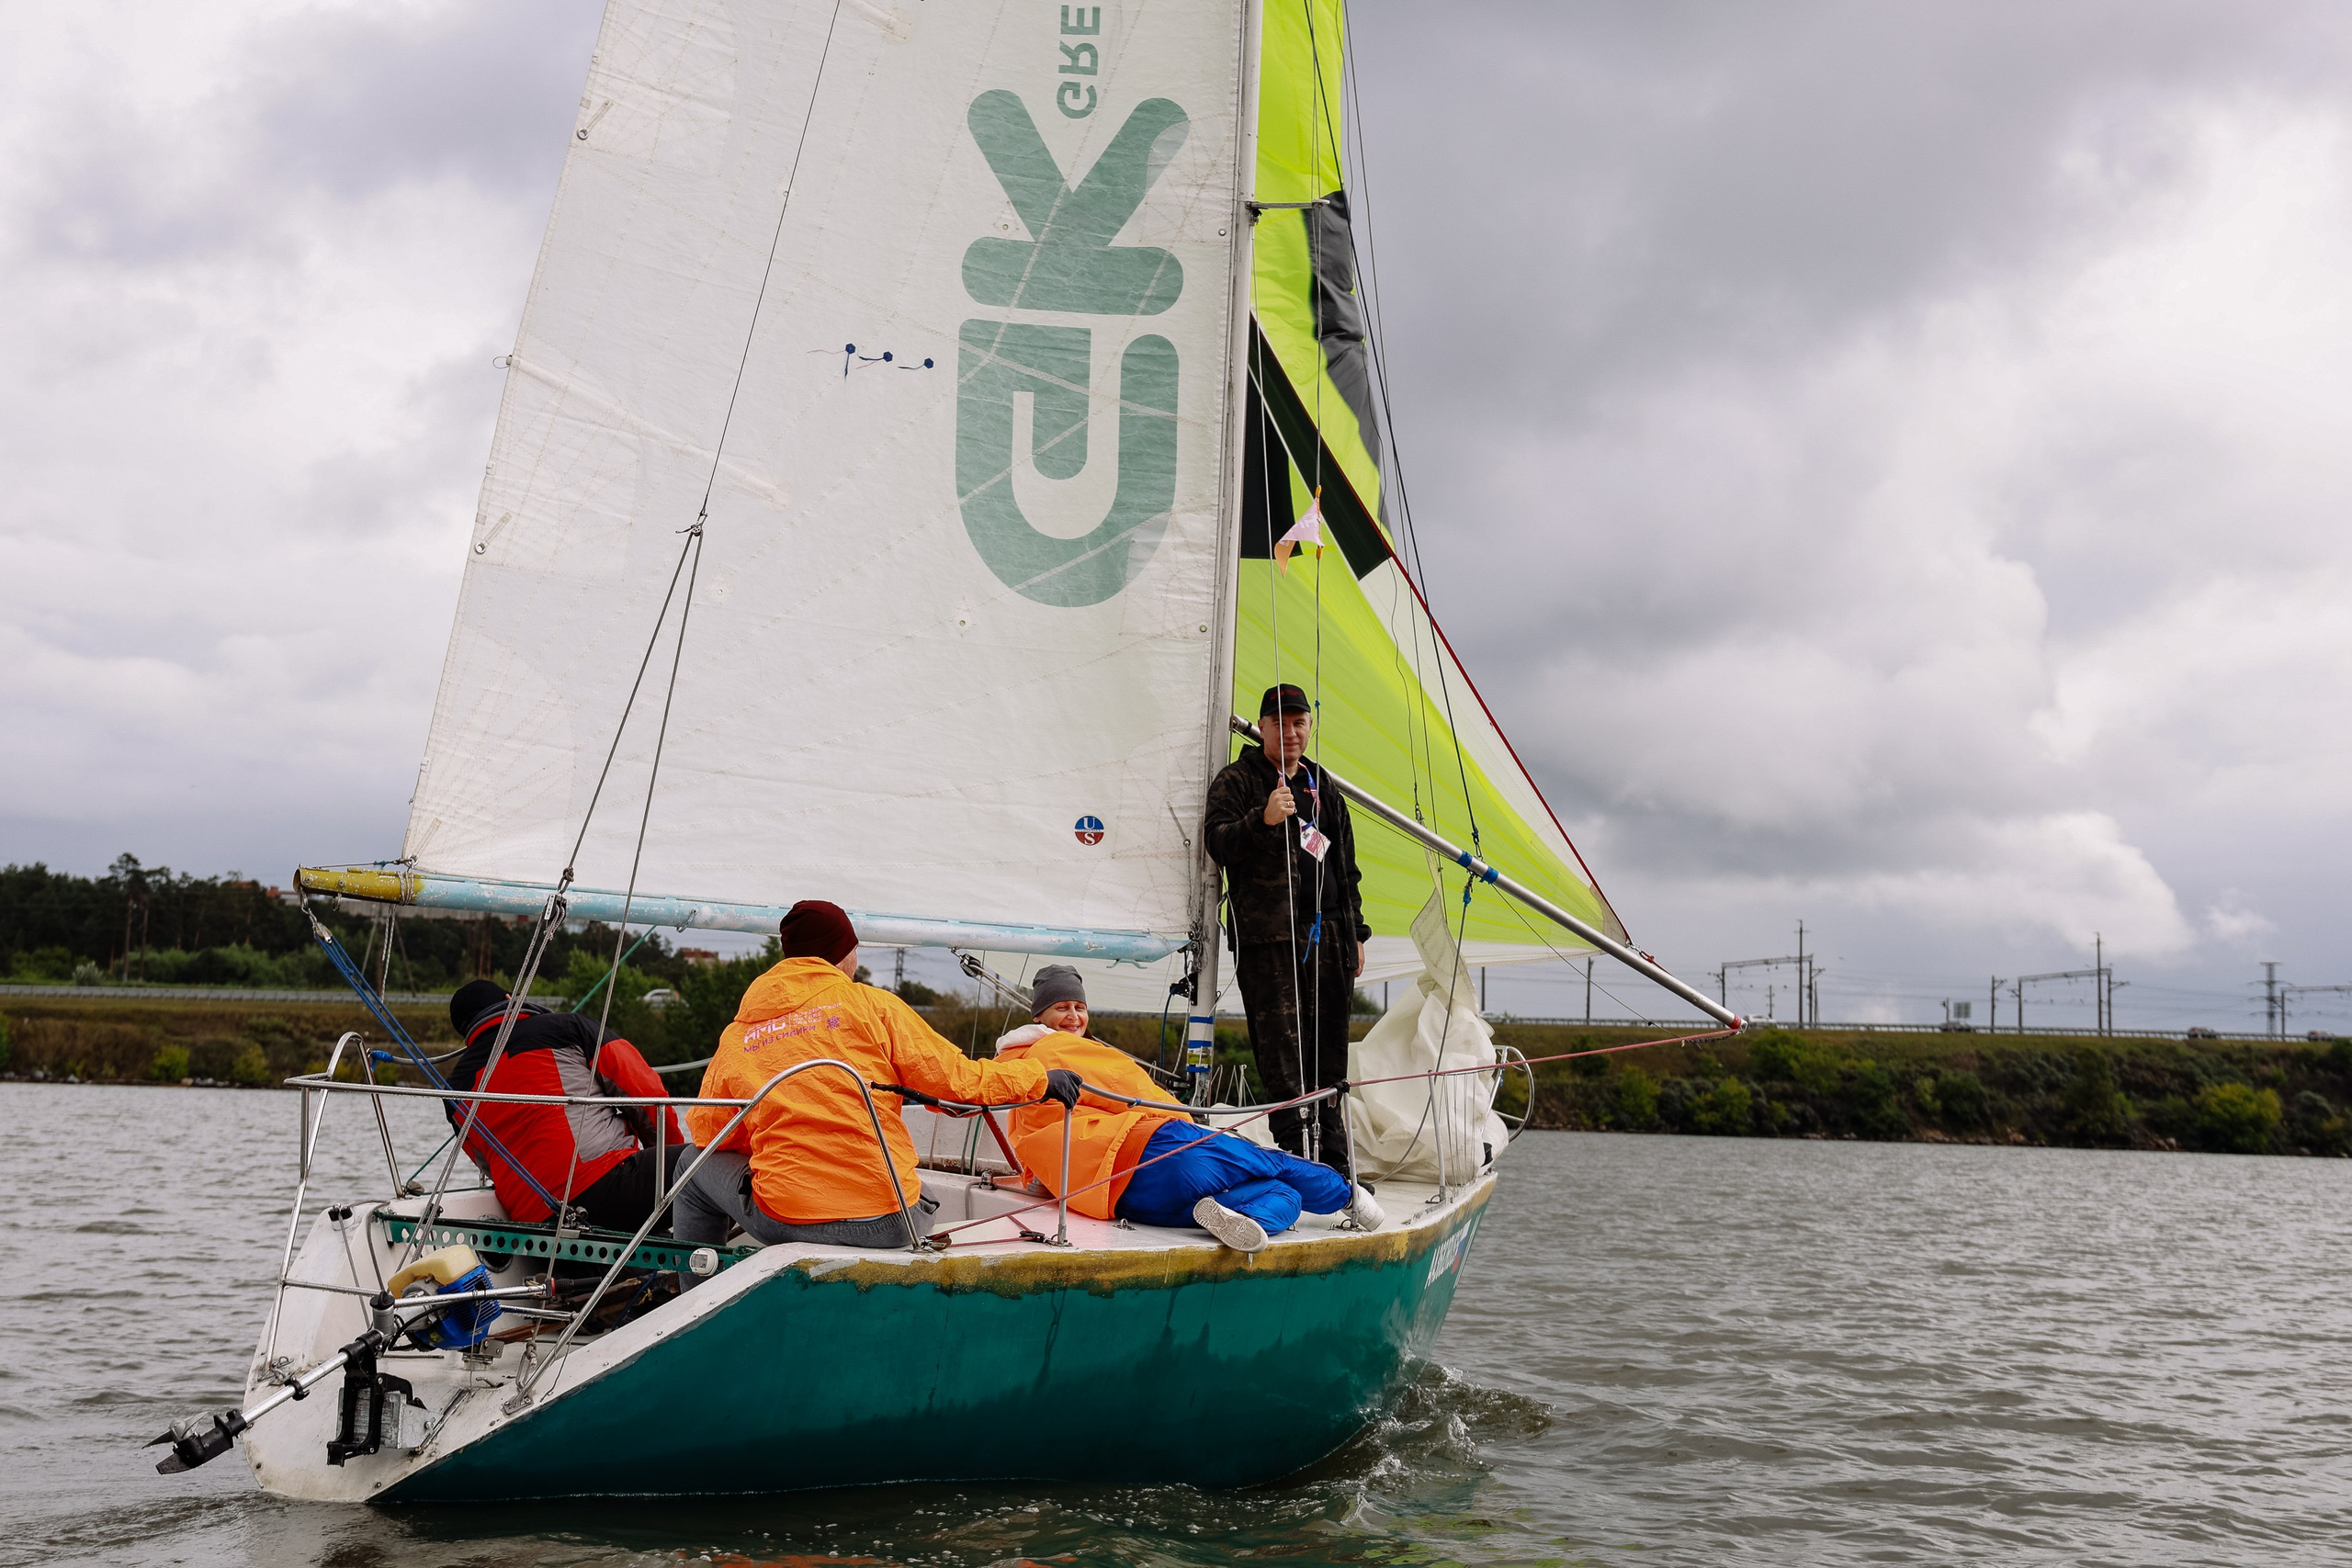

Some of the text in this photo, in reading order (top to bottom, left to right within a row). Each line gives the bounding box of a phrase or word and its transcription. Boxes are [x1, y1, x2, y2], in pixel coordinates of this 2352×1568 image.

[743, 1024, 817, 1054] МЫ ИЗ СИБИРИ
